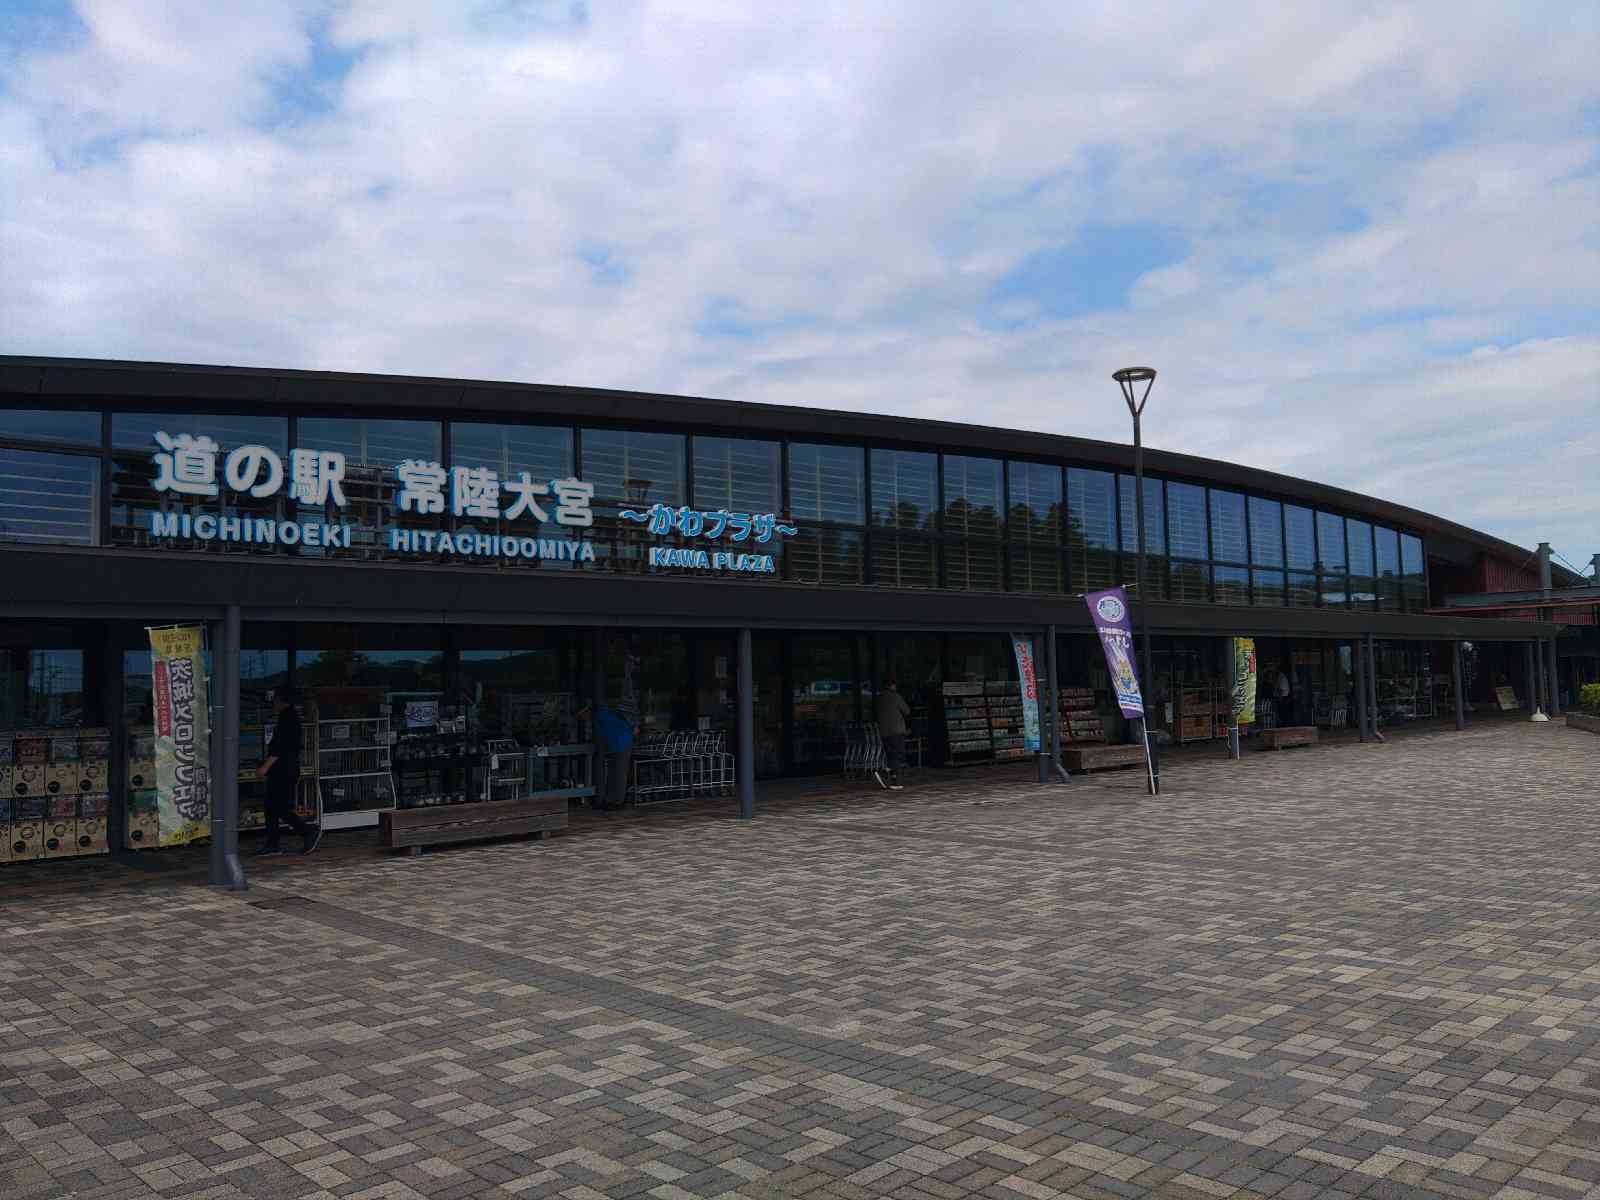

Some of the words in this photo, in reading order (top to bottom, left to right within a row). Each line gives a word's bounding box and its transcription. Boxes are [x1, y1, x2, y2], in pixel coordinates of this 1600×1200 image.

[151, 431, 347, 507] 道の駅
[395, 458, 595, 527] 常陸大宮
[150, 511, 352, 549] MICHINOEKI
[389, 527, 596, 563] HITACHIOOMIYA
[648, 546, 710, 570] KAWA
[713, 552, 775, 573] PLAZA
